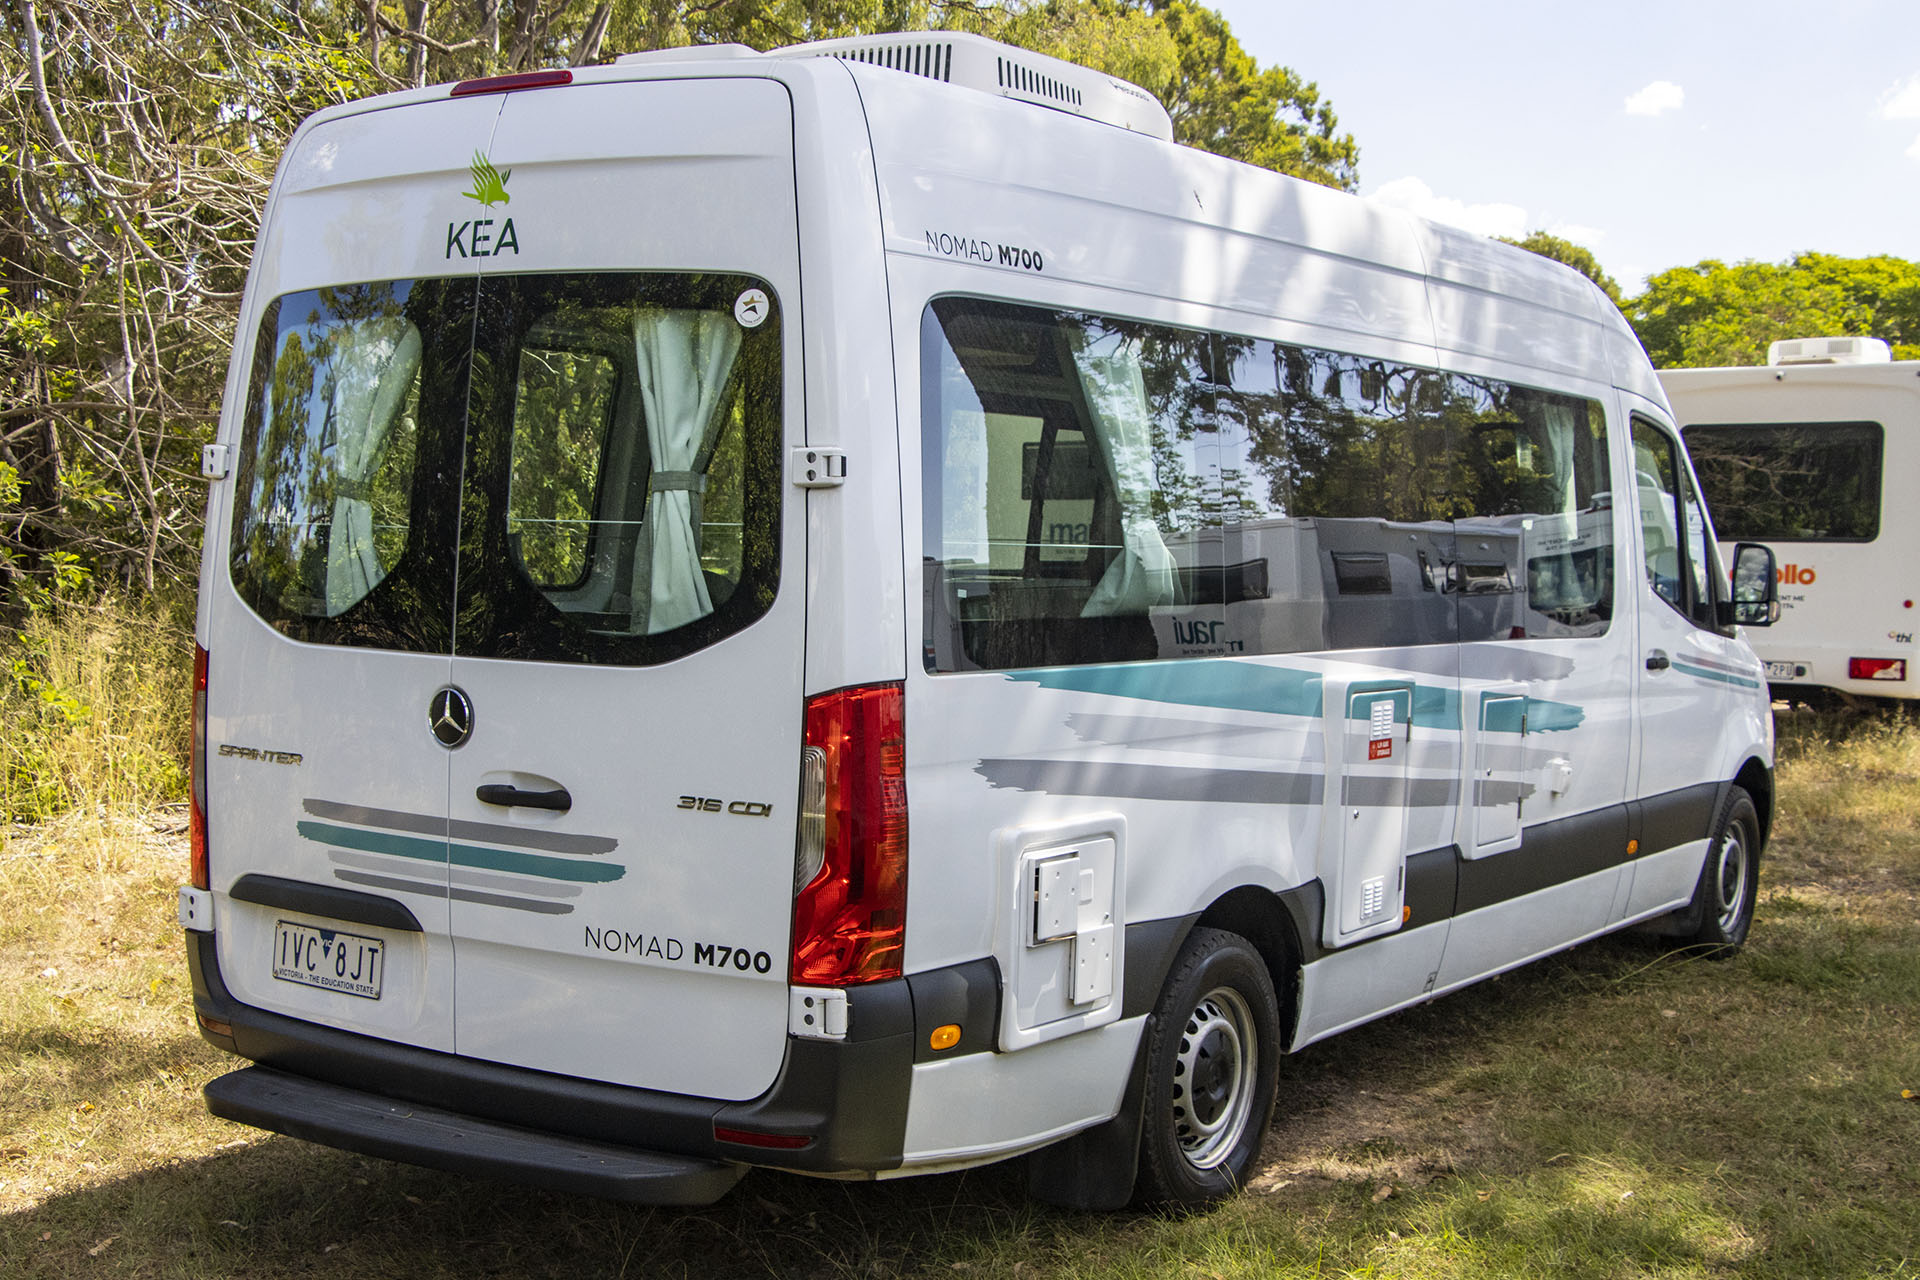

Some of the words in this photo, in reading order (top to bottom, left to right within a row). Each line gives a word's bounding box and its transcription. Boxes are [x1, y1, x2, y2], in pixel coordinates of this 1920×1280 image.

[445, 217, 520, 259] KEA
[925, 230, 993, 262] NOMAD
[998, 244, 1043, 271] M700
[218, 744, 304, 766] SPRINTER
[677, 796, 722, 812] 316
[728, 801, 773, 817] CDI
[282, 930, 317, 971] 1VC
[336, 942, 379, 984] 8JT
[585, 926, 684, 961] NOMAD
[694, 942, 772, 974] M700
[278, 968, 304, 979] VICTORIA
[309, 974, 320, 984] THE
[321, 977, 354, 990] EDUCATION
[355, 984, 374, 995] STATE
